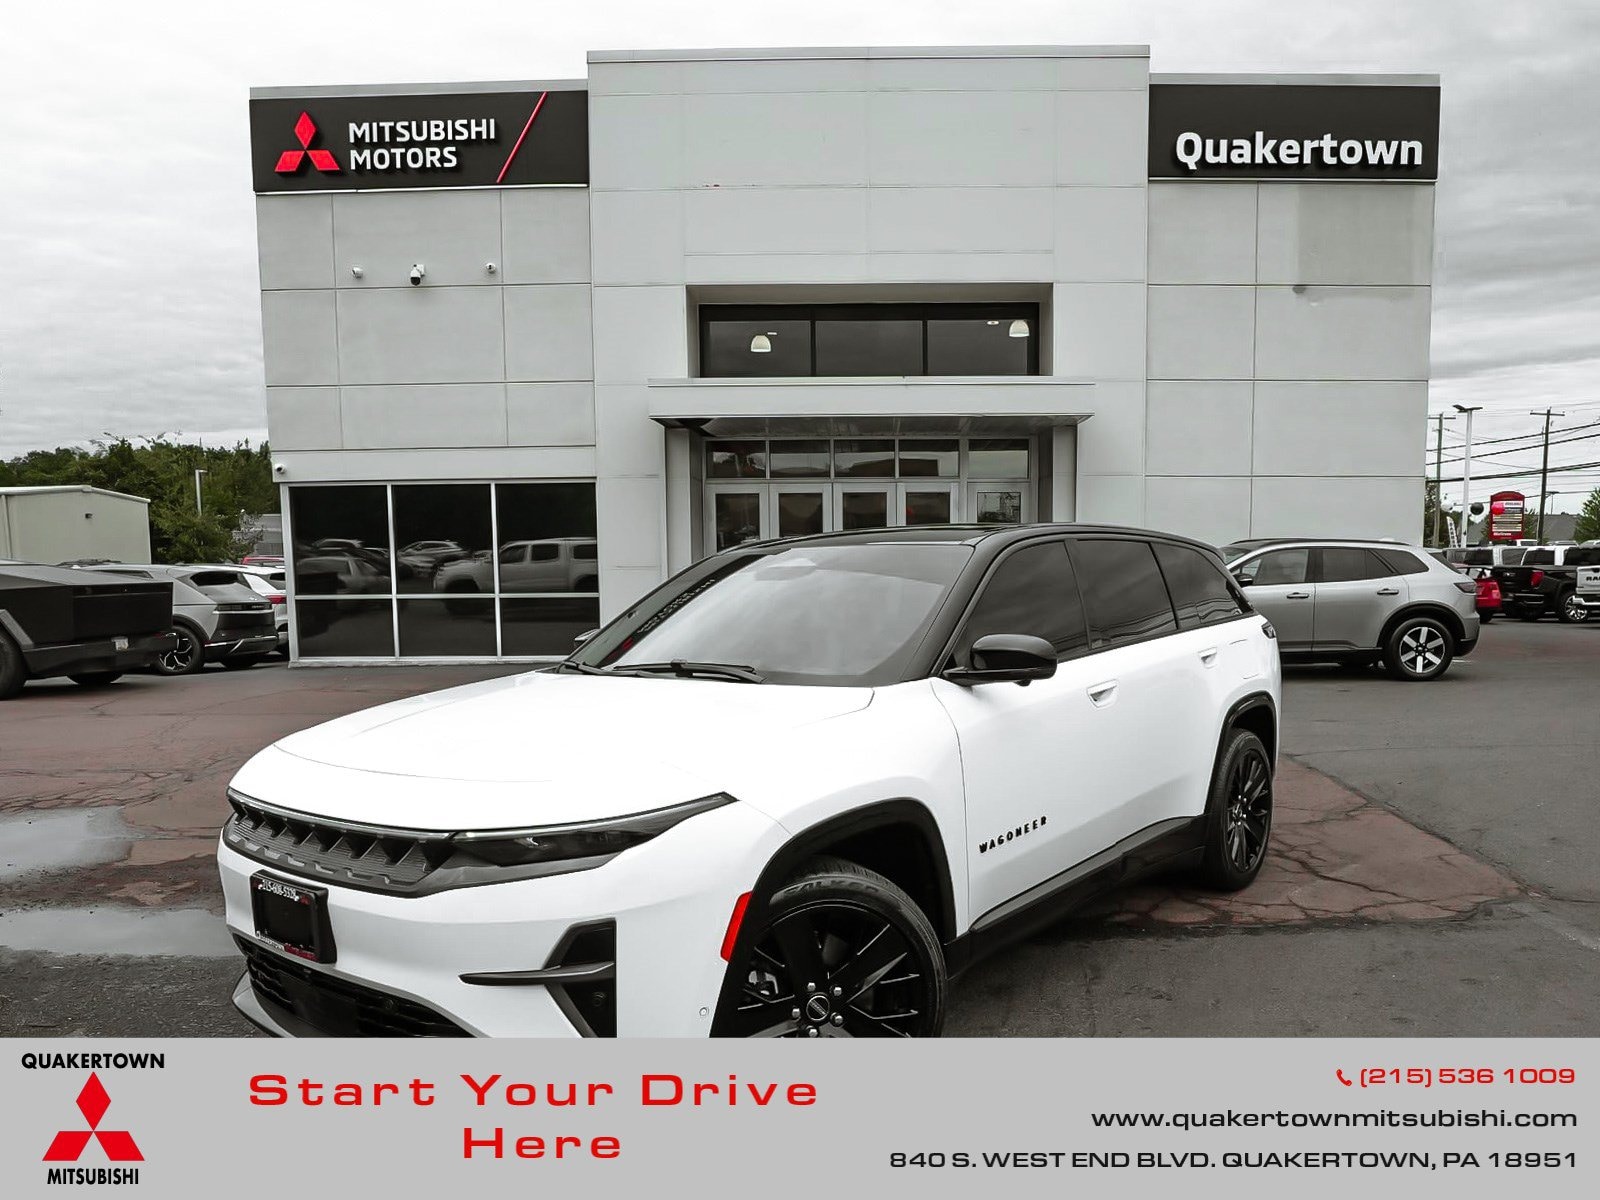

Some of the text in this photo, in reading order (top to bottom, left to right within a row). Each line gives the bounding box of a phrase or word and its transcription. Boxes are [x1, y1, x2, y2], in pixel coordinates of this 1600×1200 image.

[349, 118, 496, 143] MITSUBISHI
[349, 147, 457, 170] MOTORS
[1176, 131, 1423, 170] Quakertown
[979, 816, 1047, 853] WAGONEER
